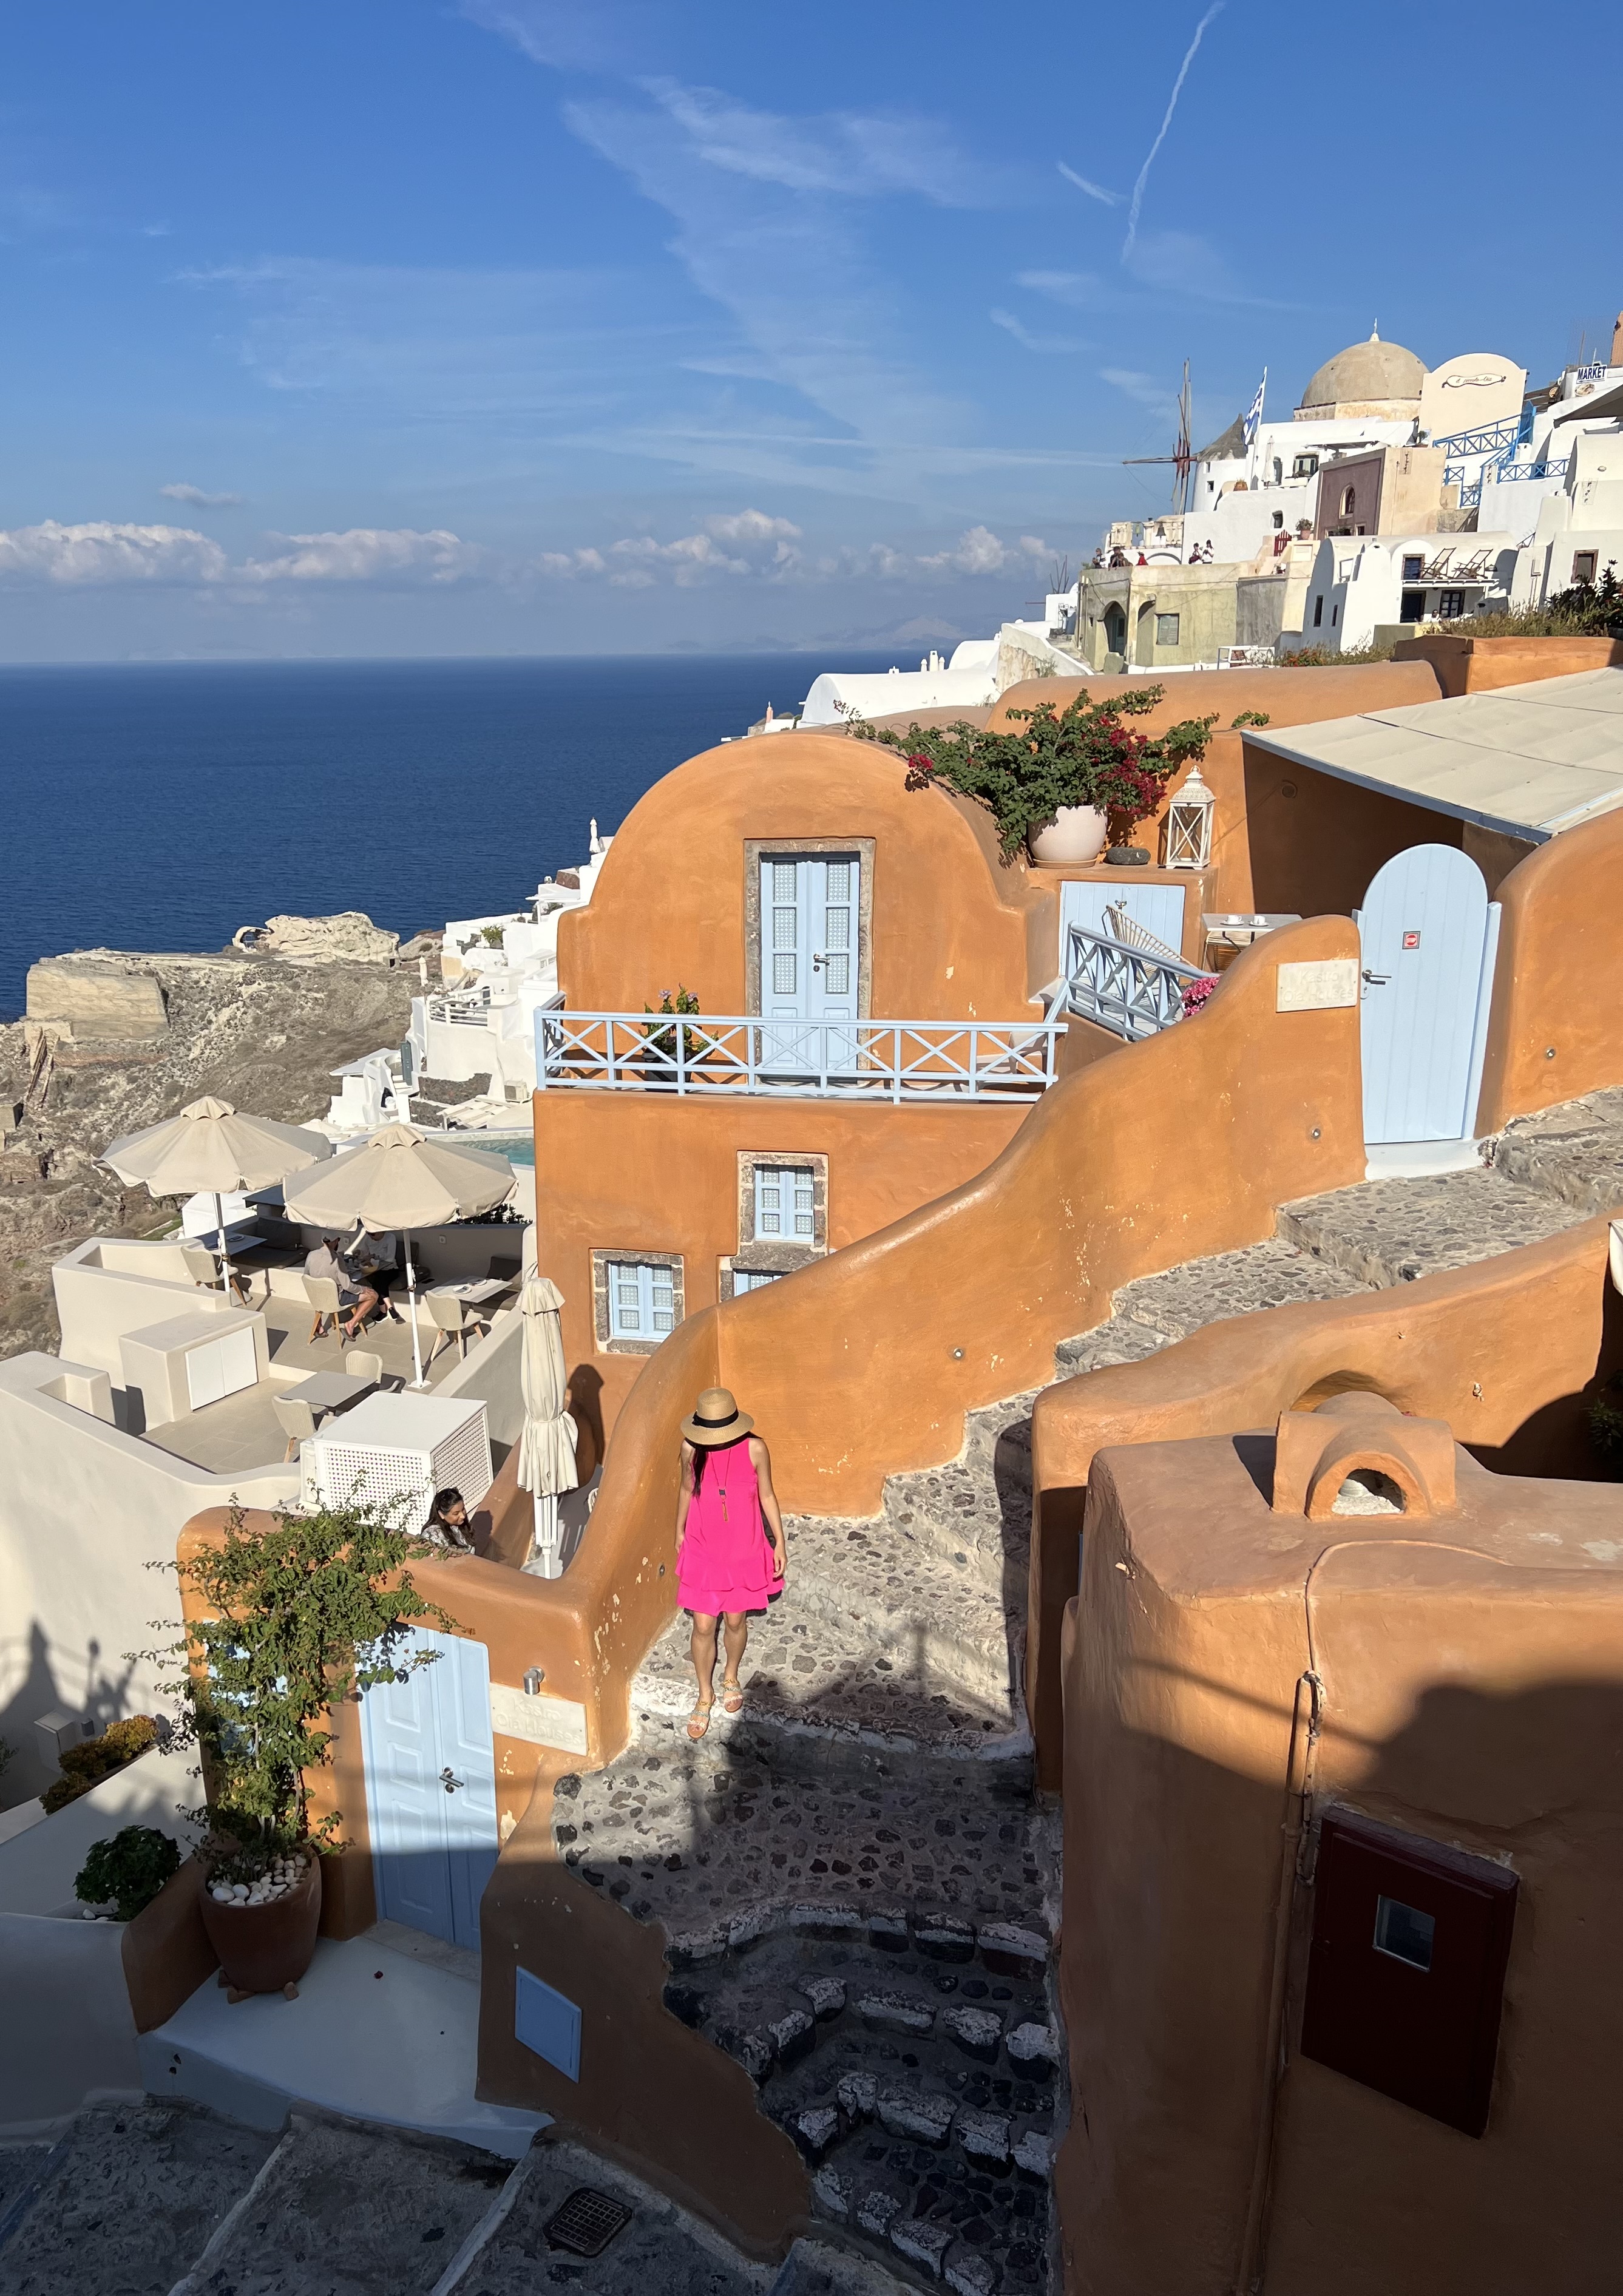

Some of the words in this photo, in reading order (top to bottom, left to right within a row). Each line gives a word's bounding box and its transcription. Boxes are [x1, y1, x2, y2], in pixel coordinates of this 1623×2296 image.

[1577, 366, 1607, 381] MARKET
[1299, 970, 1340, 984] Kastro
[1282, 989, 1306, 1003] Oia
[1308, 985, 1354, 1001] Houses
[513, 1697, 561, 1721] Kastro
[495, 1712, 522, 1732] Oia
[525, 1718, 581, 1746] Houses
